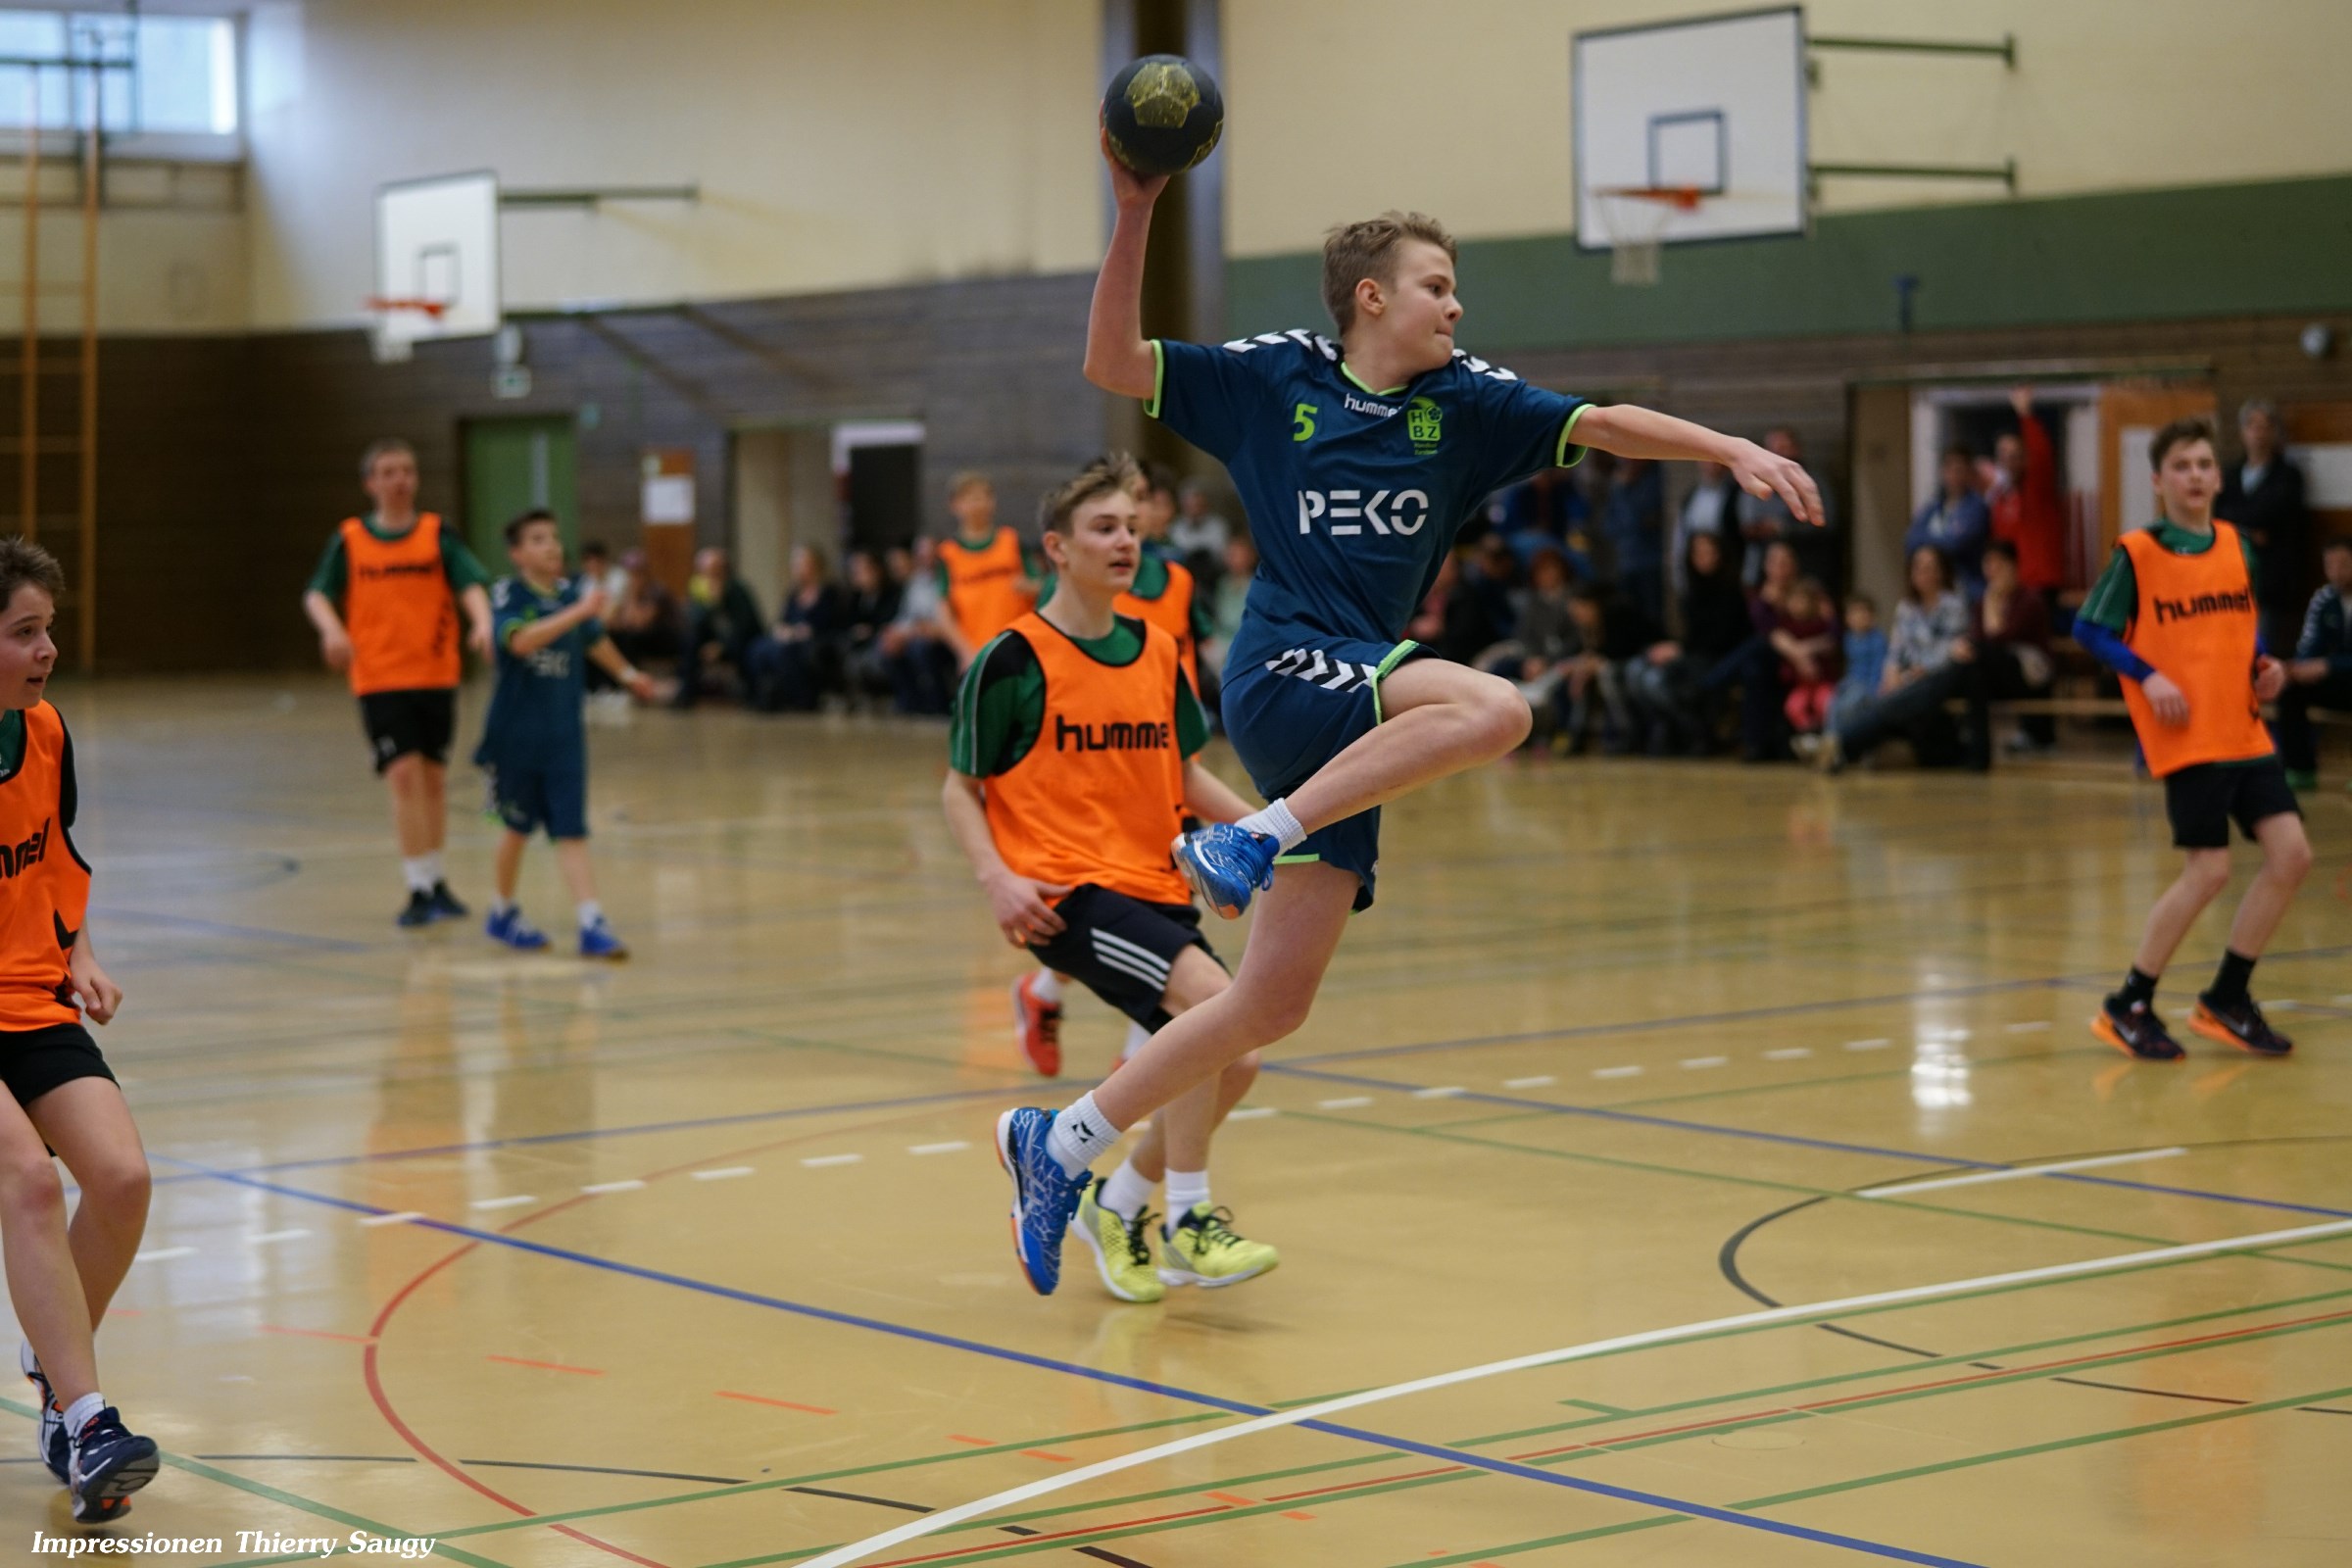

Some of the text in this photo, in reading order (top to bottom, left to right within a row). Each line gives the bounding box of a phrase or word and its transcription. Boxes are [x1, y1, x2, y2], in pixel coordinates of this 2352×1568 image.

[1293, 403, 1318, 441] 5
[1344, 392, 1402, 418] humme
[1298, 489, 1429, 535] PEKO
